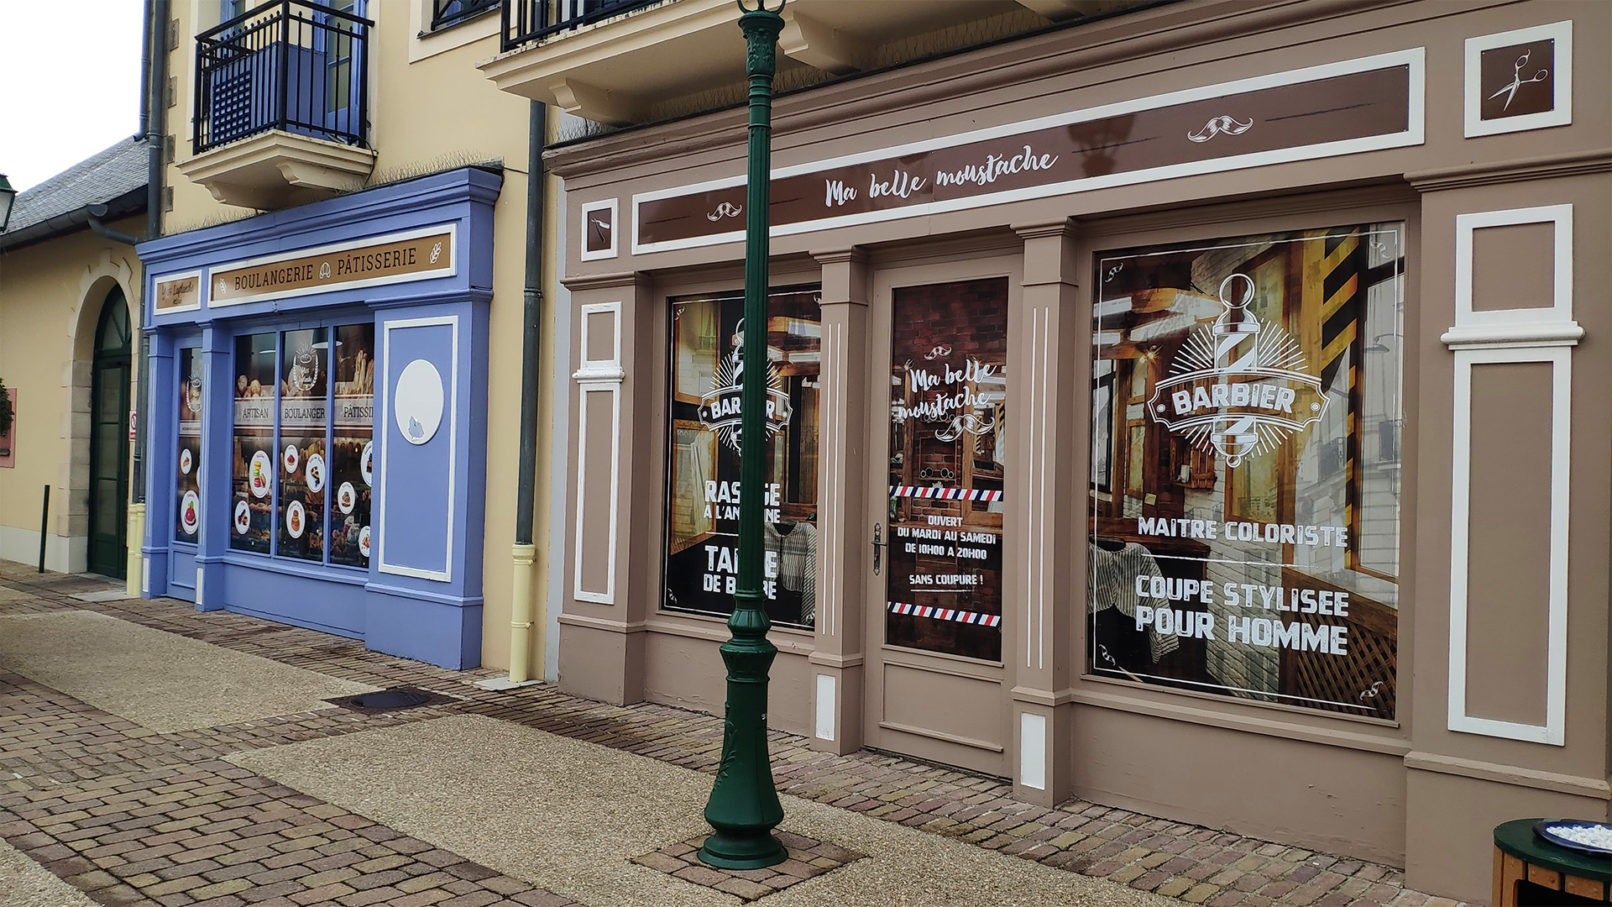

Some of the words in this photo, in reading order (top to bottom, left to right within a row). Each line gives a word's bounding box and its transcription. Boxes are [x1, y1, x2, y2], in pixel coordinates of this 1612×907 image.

[825, 179, 858, 207] Ma
[869, 169, 926, 199] belle
[936, 145, 1059, 186] moustache
[234, 264, 313, 291] BOULANGERIE
[337, 247, 417, 276] PÂTISSERIE
[910, 368, 940, 393] Ma
[944, 359, 998, 385] belle
[710, 396, 776, 420] BARR
[898, 385, 991, 420] moustache
[1172, 383, 1296, 415] BARBIER
[242, 407, 269, 419] ARTISAN
[284, 407, 326, 419] BOULANGER
[343, 403, 374, 418] PÂTISSI
[703, 504, 713, 519] A
[927, 515, 963, 528] OUVERT
[897, 527, 910, 537] DU
[943, 531, 958, 541] AU
[1137, 516, 1217, 539] MAITRE
[1225, 521, 1348, 548] COLORISTE
[905, 542, 917, 553] DE
[947, 546, 955, 557] A
[956, 547, 987, 560] 20H00
[703, 574, 721, 593] DE
[909, 574, 933, 585] SANS
[935, 574, 978, 585] COUPURE
[1135, 575, 1214, 604] COUPE
[1223, 582, 1349, 617] STYLISEE
[1135, 606, 1215, 640] POUR
[1228, 615, 1348, 656] HOMME
